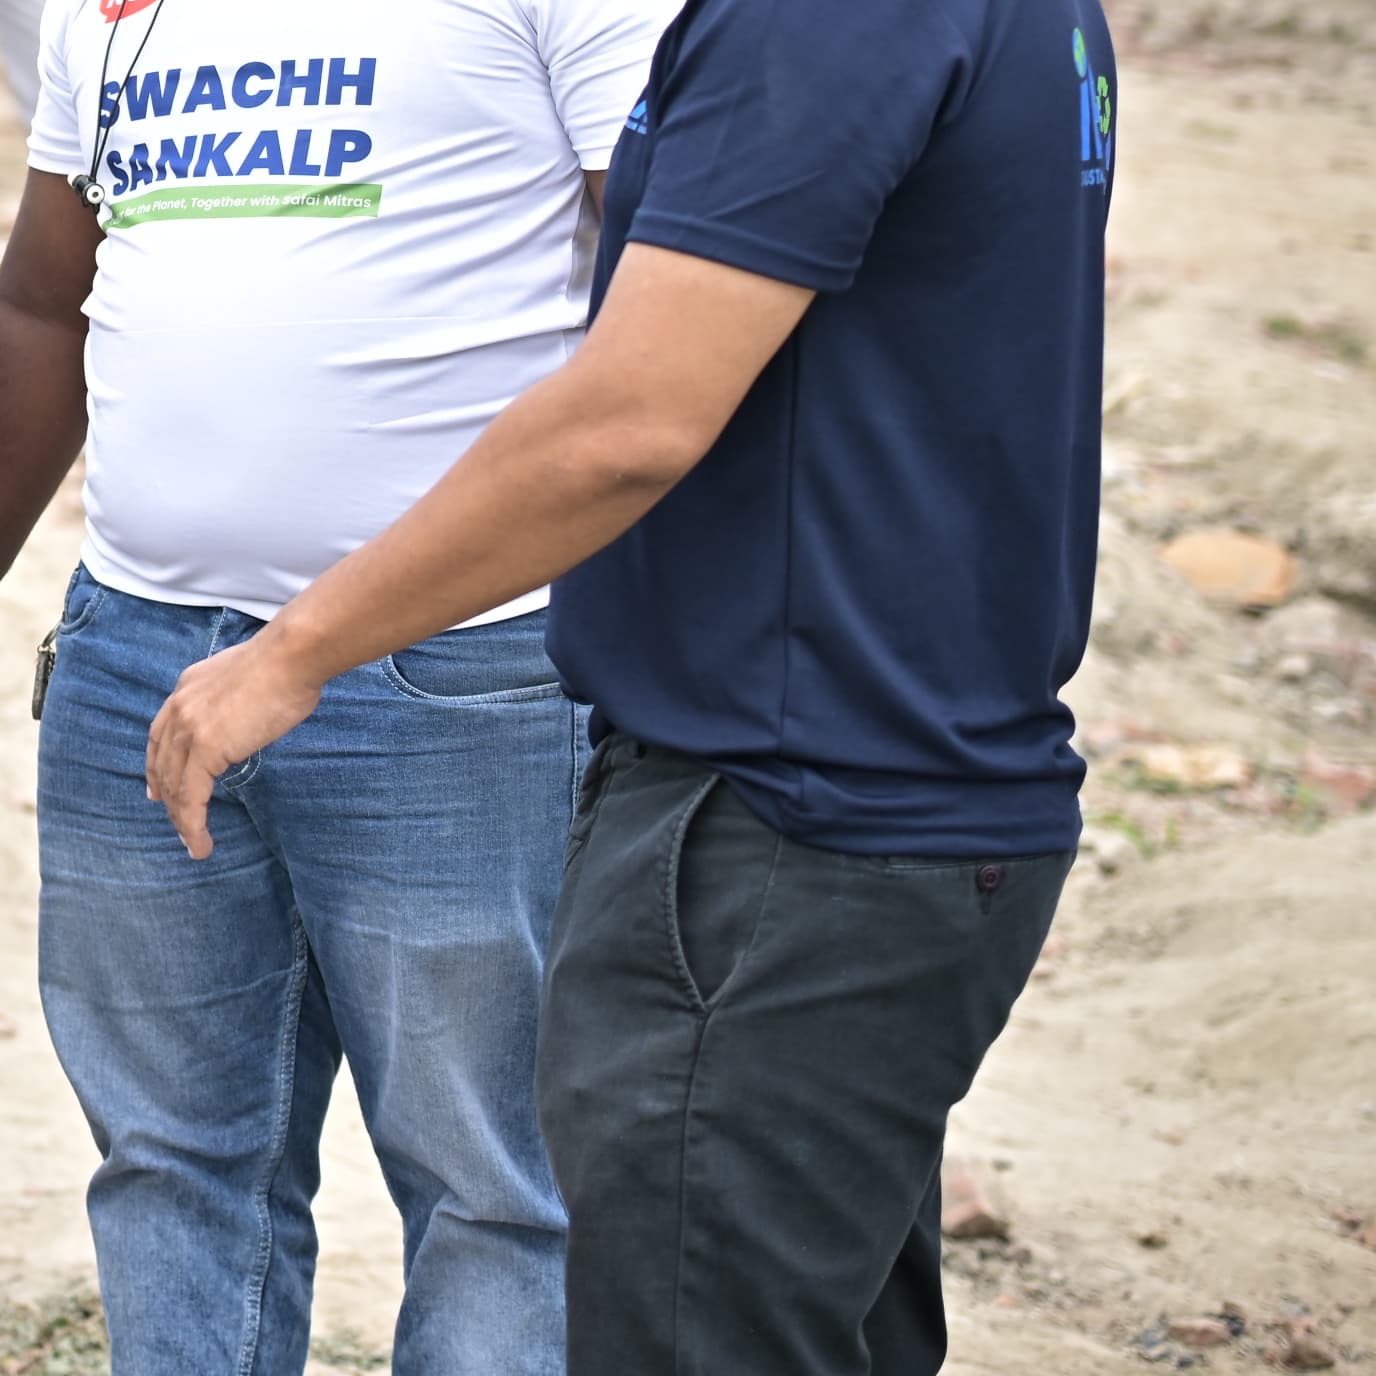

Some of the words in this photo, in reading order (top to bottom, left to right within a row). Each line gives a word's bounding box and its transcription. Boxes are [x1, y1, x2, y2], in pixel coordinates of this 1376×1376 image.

[100, 57, 377, 129] SWACHH
[106, 129, 373, 195] SANKALP
[191, 196, 247, 212] Together
[250, 195, 280, 207] with
[323, 194, 372, 208] Mitras
